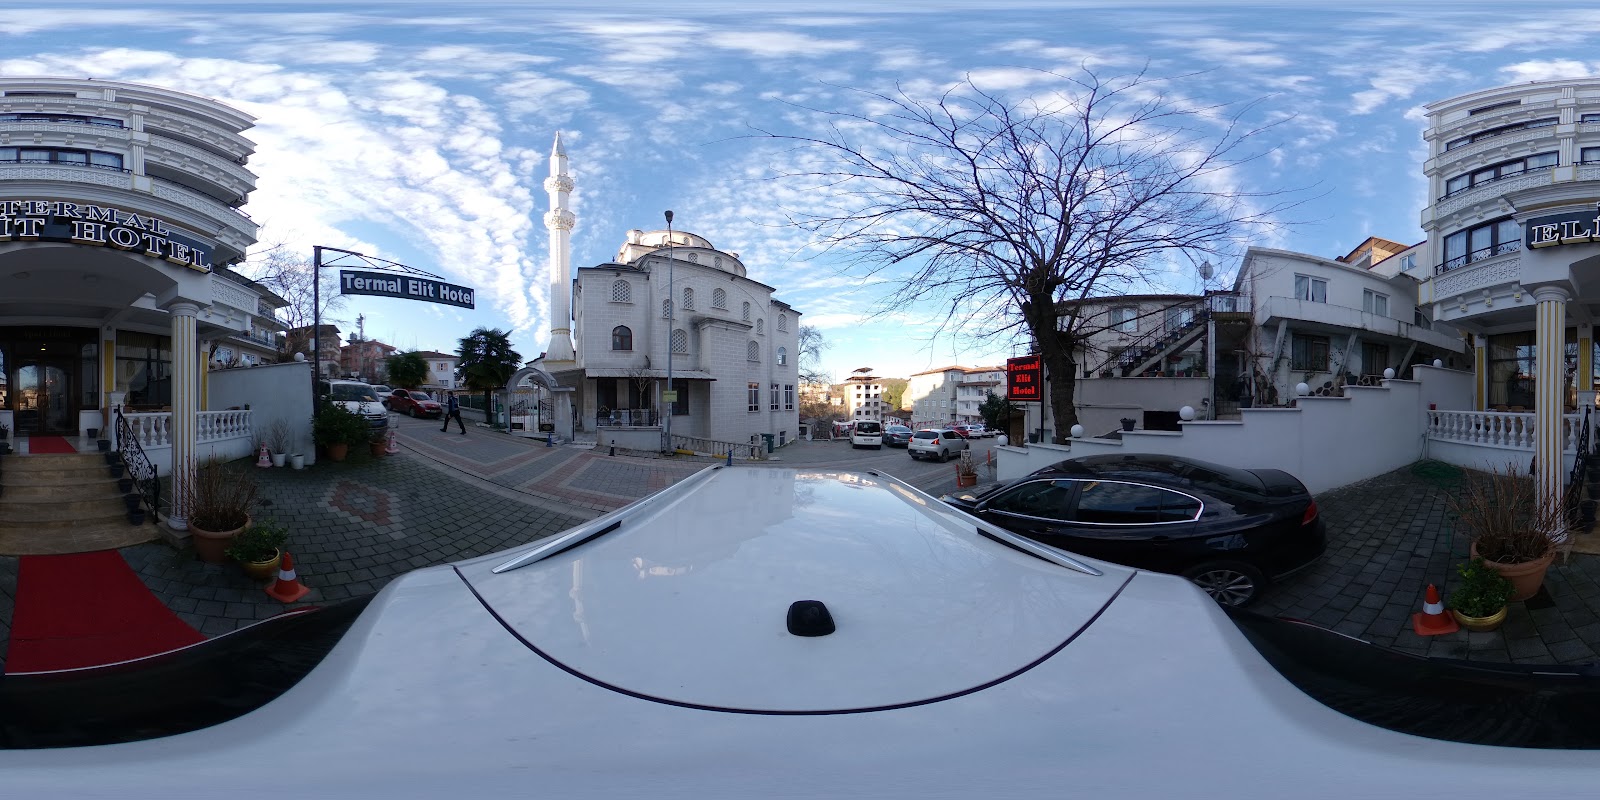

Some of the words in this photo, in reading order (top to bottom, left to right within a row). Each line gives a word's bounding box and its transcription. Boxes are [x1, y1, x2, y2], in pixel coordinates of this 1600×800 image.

[0, 200, 169, 236] TERMAL
[71, 220, 211, 271] HOTEL
[343, 274, 401, 293] Termal
[409, 280, 434, 297] Elit
[440, 285, 474, 305] Hotel
[1010, 361, 1039, 371] Termal
[1016, 374, 1031, 382] Elit
[1013, 386, 1035, 394] Hotel
